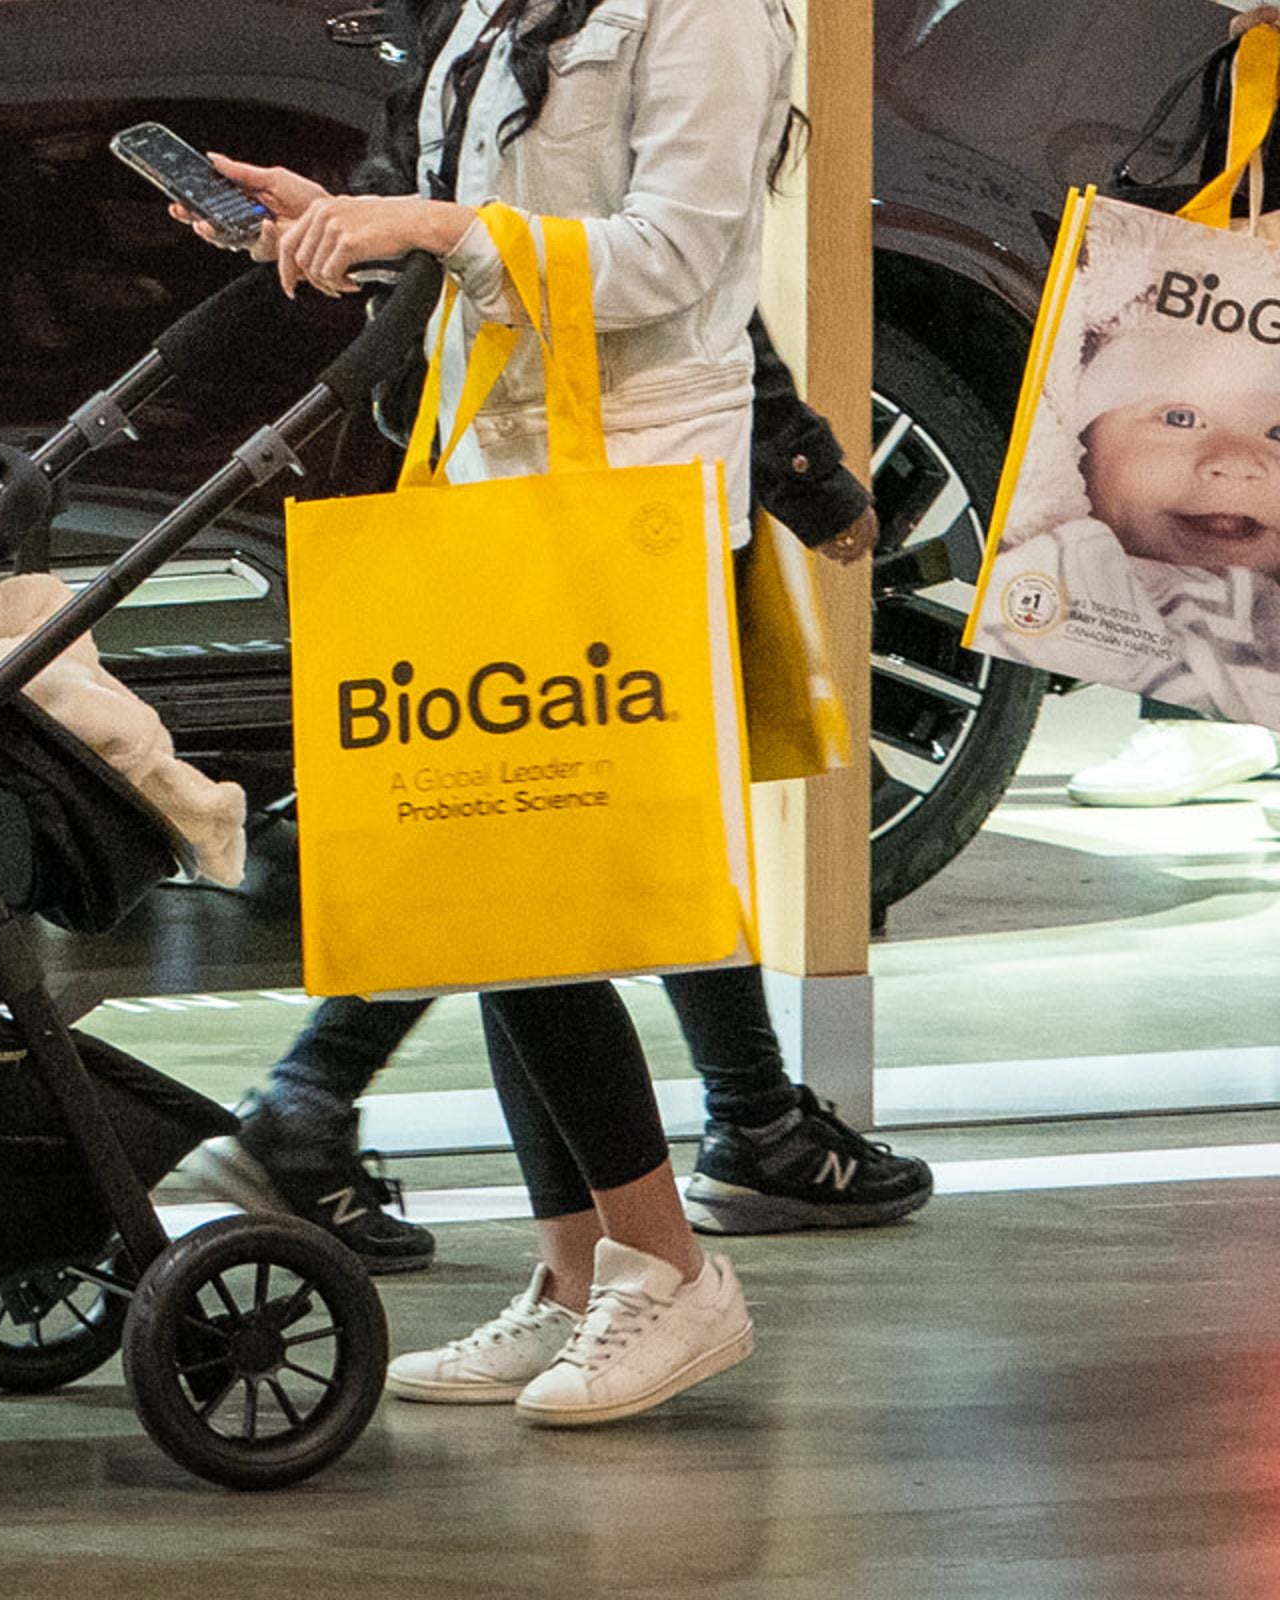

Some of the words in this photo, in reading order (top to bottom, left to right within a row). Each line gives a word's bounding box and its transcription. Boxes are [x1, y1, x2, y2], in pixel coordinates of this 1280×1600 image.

[338, 641, 667, 750] BioGaia
[413, 763, 492, 793] Global
[500, 757, 585, 785] Leader
[397, 794, 507, 824] Probiotic
[513, 788, 610, 813] Science
